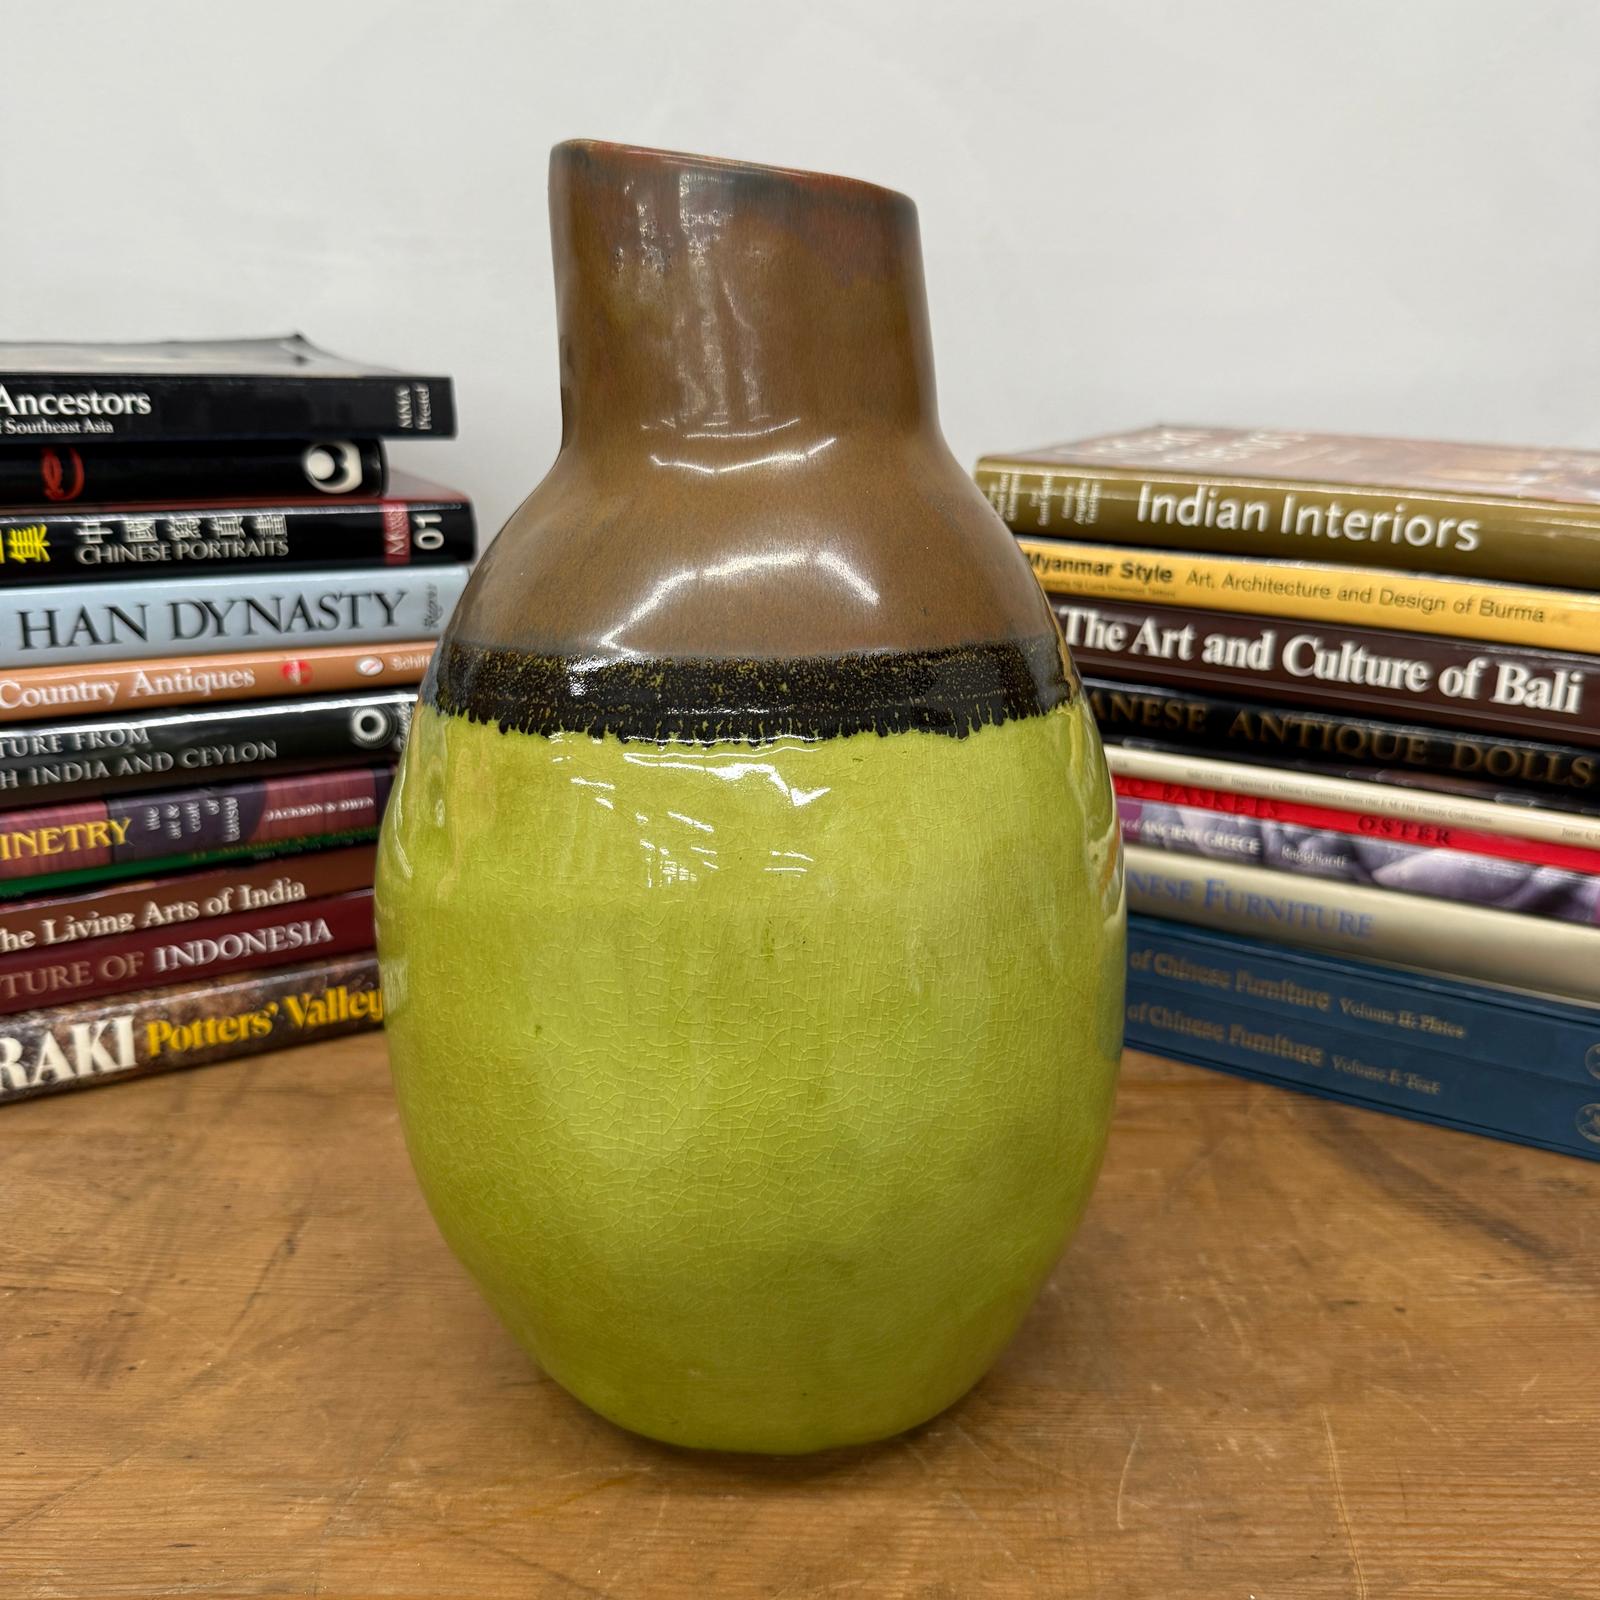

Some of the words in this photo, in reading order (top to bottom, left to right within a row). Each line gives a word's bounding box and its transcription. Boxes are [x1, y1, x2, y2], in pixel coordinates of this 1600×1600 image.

[0, 383, 152, 415] Ancestors
[4, 417, 81, 434] Southeast
[84, 417, 114, 433] Asia
[413, 513, 444, 550] 01
[1136, 482, 1269, 535] Indian
[1277, 494, 1481, 552] Interiors
[75, 543, 171, 564] CHINESE
[175, 539, 289, 561] PORTRAITS
[1120, 560, 1173, 585] Style
[1186, 569, 1215, 588] Art,
[1221, 572, 1331, 600] Architecture
[1337, 587, 1372, 604] and
[1379, 588, 1446, 615] Design
[1453, 598, 1476, 614] of
[1479, 600, 1545, 623] Burma
[17, 603, 150, 651] HAN
[168, 591, 407, 642] DYNASTY
[0, 678, 118, 709] Country
[130, 667, 256, 698] Antiques
[1058, 605, 1127, 652] The
[1130, 615, 1195, 661] Art
[1202, 631, 1275, 672] and
[1282, 633, 1432, 693] Culture
[1438, 656, 1490, 700] of
[1490, 661, 1585, 714] Bali
[28, 759, 110, 786] INDIA
[113, 751, 174, 776] AND
[177, 740, 277, 769] CEYLON
[73, 728, 150, 750] FROM
[1228, 708, 1429, 763] ANTIQUE
[1452, 741, 1596, 788] DOLLS
[0, 817, 131, 861] INETRY
[1142, 820, 1200, 843] ANCIENT
[1204, 831, 1261, 855] GREECE
[1359, 816, 1450, 844] OSTER
[42, 913, 135, 946] Living
[141, 900, 200, 928] Arts
[201, 888, 235, 915] of
[239, 877, 306, 908] India
[1204, 878, 1374, 936] FURNITURE
[1, 959, 94, 1000] TURE
[101, 951, 144, 981] OF
[153, 918, 334, 972] INDONESIA
[1131, 951, 1154, 970] of
[1154, 953, 1231, 989] Chinese
[1236, 969, 1331, 1011] Furniture
[1339, 997, 1394, 1024] Volume
[0, 1015, 138, 1092] RAKI
[285, 987, 382, 1028] Valley
[1128, 1004, 1149, 1022] of
[1150, 1005, 1224, 1041] Chinese
[1228, 1023, 1324, 1066] Furniture
[1332, 1054, 1386, 1081] Volume
